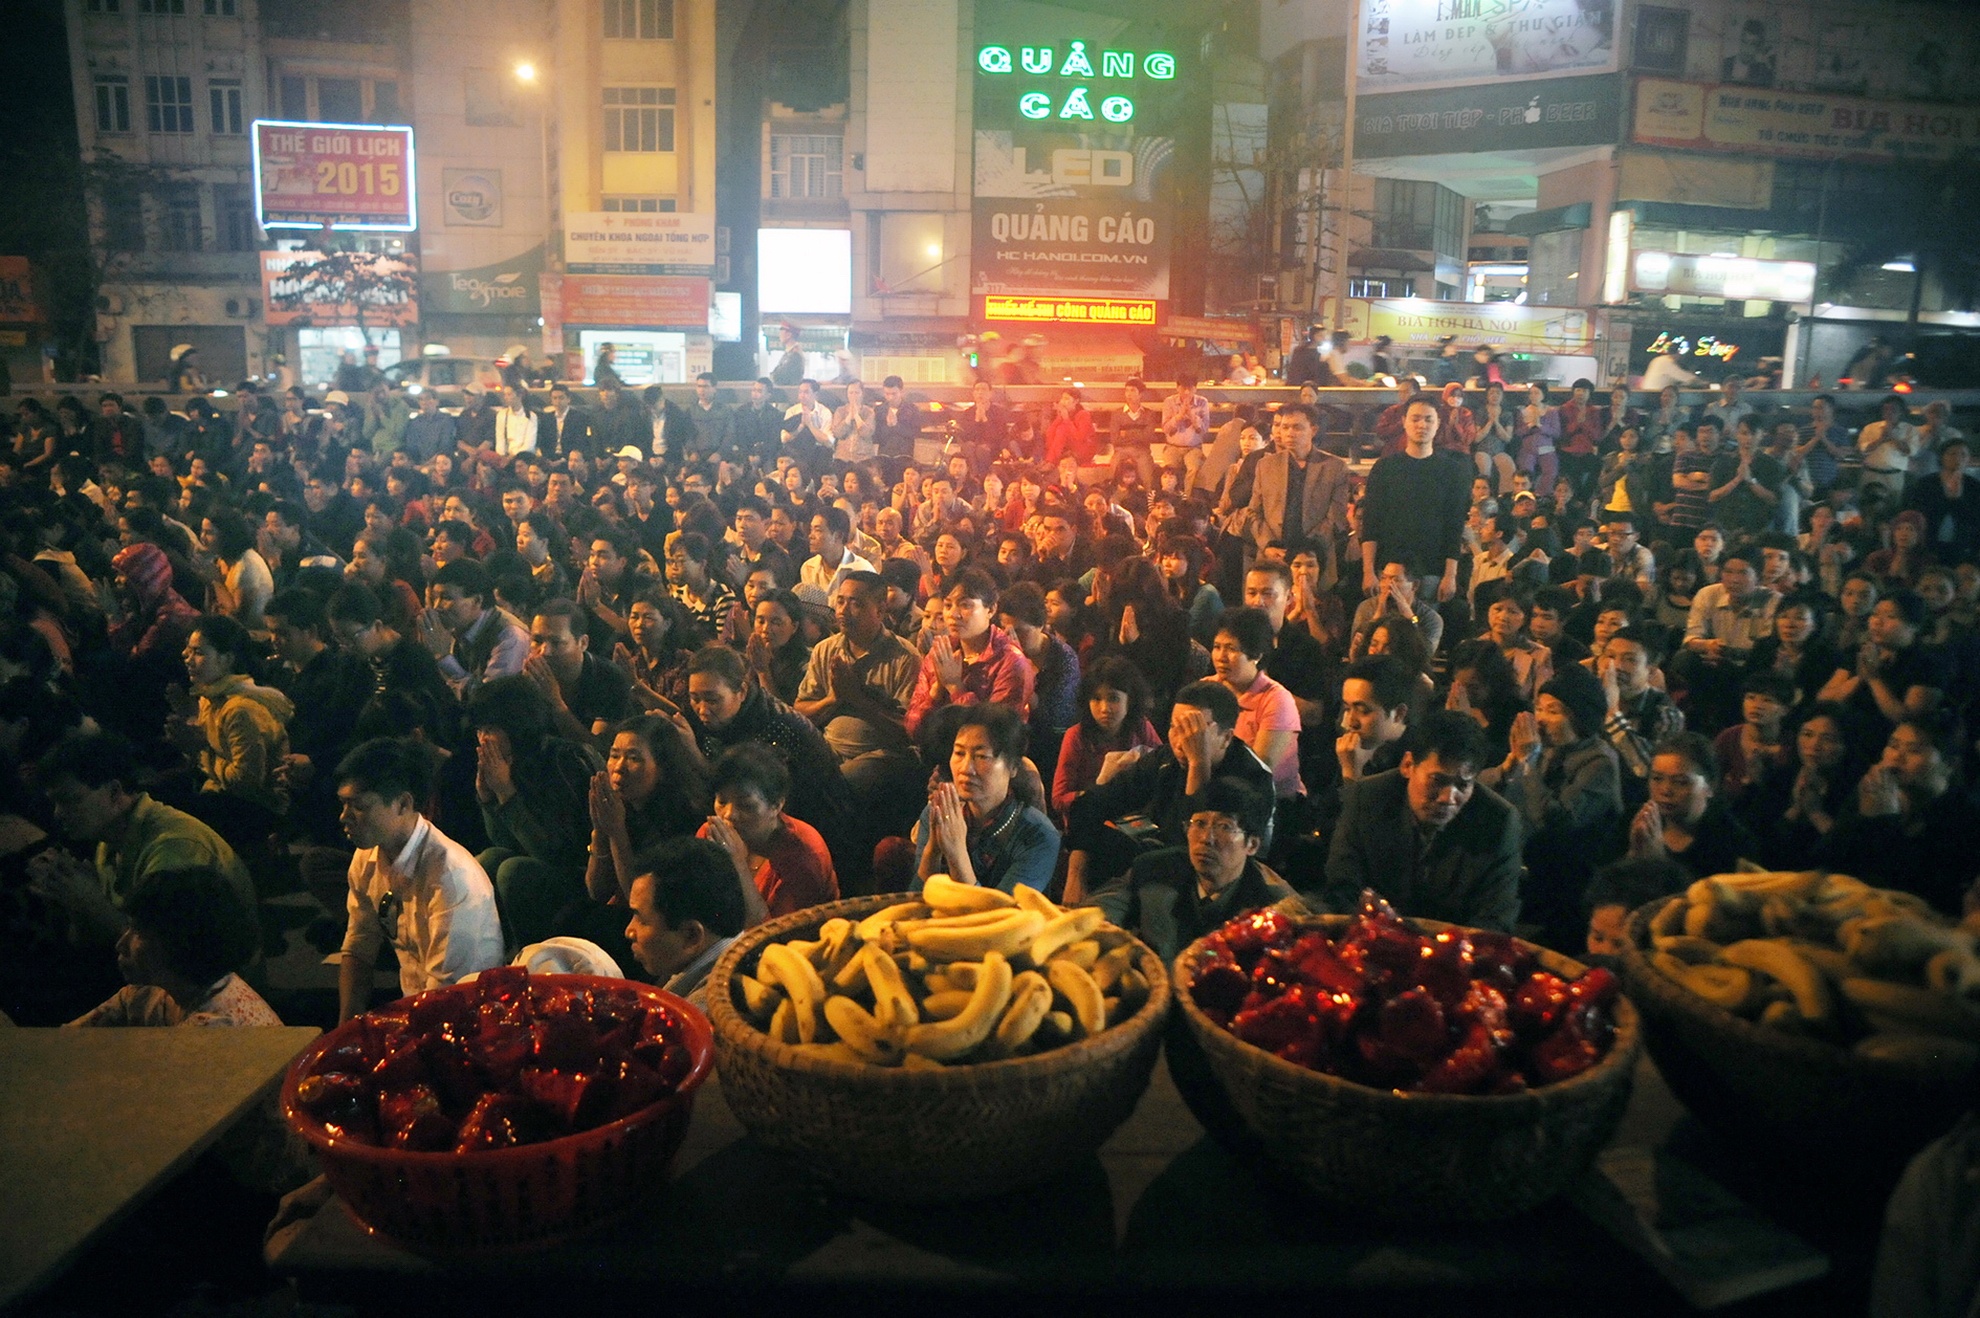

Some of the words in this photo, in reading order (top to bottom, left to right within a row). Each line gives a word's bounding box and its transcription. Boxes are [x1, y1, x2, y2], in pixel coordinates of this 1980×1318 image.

[1404, 28, 1436, 45] LÀM
[1446, 26, 1476, 41] ĐẸP
[1485, 23, 1497, 37] &
[1507, 17, 1543, 34] THƯ
[979, 41, 1175, 79] QUẢNG
[1020, 88, 1133, 122] CÁO
[1364, 117, 1392, 134] BIA
[1546, 102, 1596, 123] BEER
[1831, 107, 1890, 133] BIA
[270, 132, 305, 152] THẾ
[312, 131, 352, 154] GIỚI
[357, 137, 399, 160] LỊCH
[317, 160, 400, 196] 2015
[1013, 147, 1133, 186] LED
[570, 231, 606, 242] CHUYÊN
[608, 233, 632, 242] KHOA
[666, 231, 689, 243] TỔNG
[691, 233, 709, 244] HỢP
[991, 203, 1089, 243] QUẢNG
[1098, 212, 1154, 245] CÁO
[997, 251, 1020, 260] HC
[1023, 252, 1148, 264] HANOI.COM.VN
[1056, 302, 1087, 318] CÔNG
[1089, 302, 1127, 320] QUẢNG
[1129, 305, 1152, 320] CÁO
[1398, 315, 1424, 327] BIA
[1463, 316, 1485, 330] HÀ
[1490, 318, 1519, 332] NỘI
